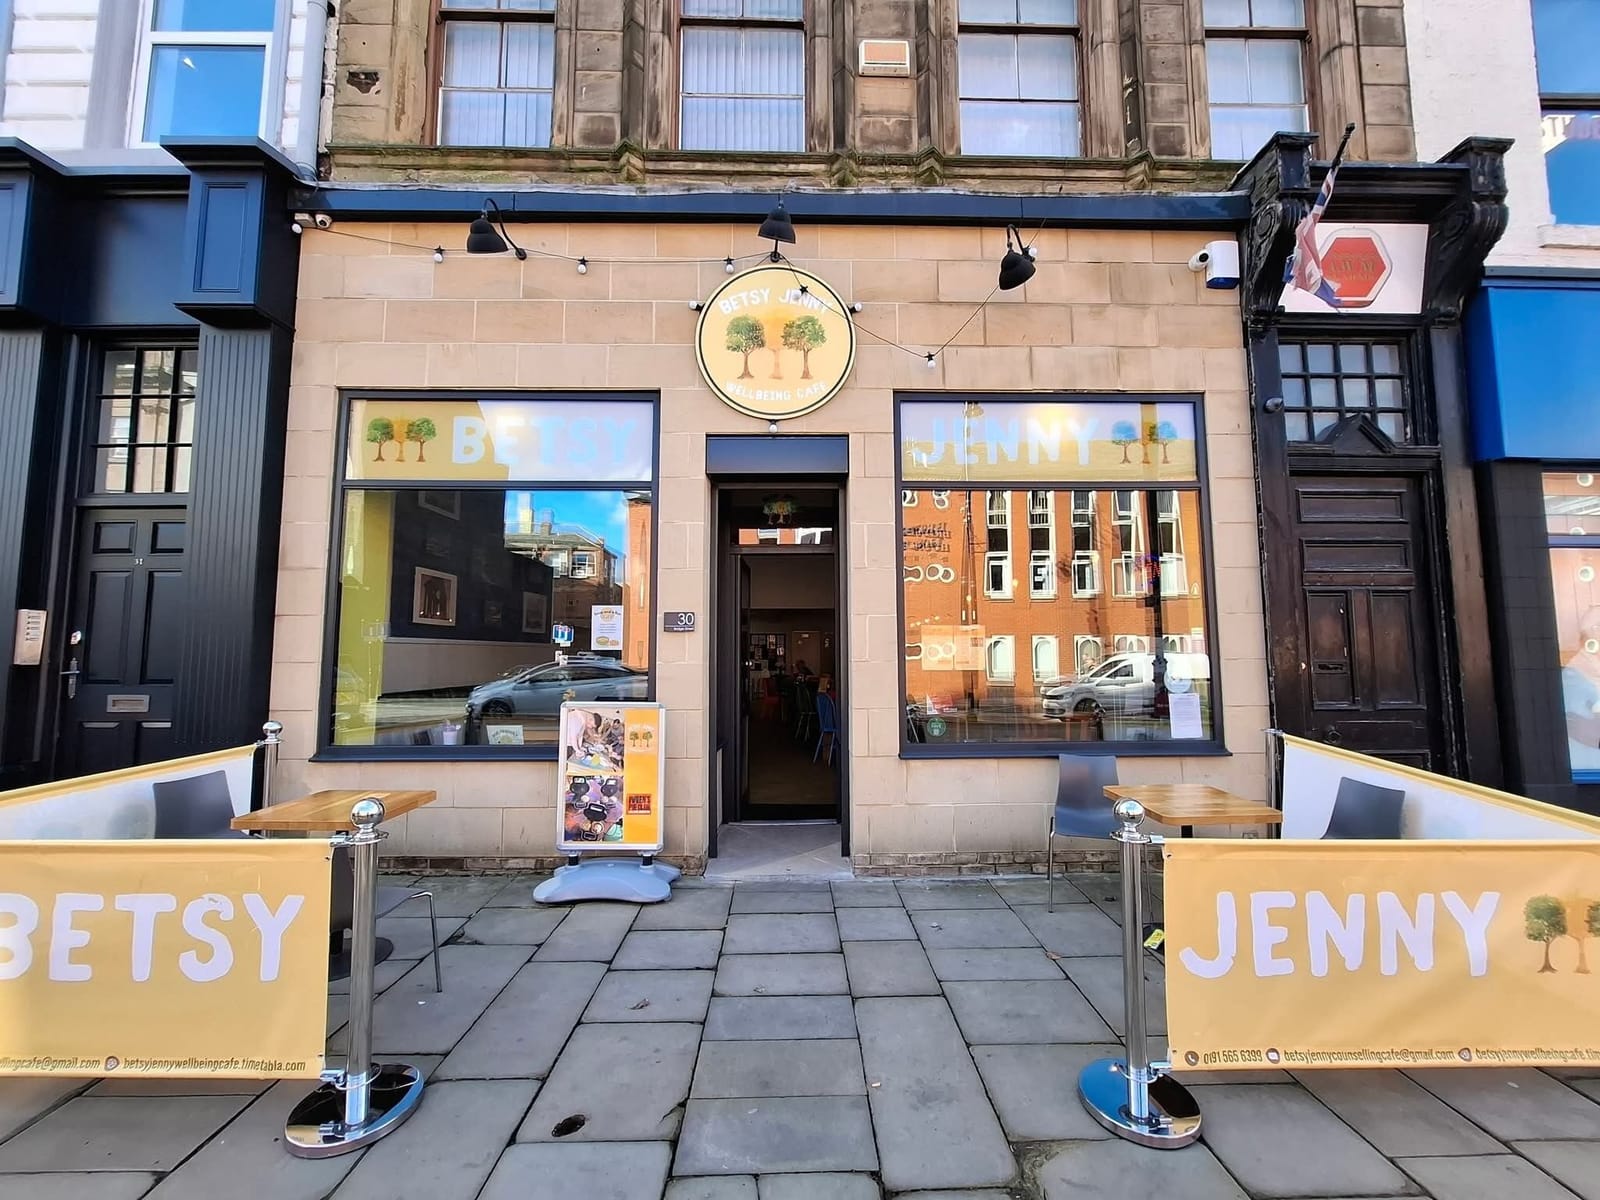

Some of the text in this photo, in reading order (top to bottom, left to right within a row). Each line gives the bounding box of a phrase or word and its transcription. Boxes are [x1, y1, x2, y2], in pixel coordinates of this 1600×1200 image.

[719, 287, 834, 315] BETSY JENNY
[725, 381, 827, 401] WELLBEING CAFE
[452, 415, 638, 465] BETSY
[917, 416, 1099, 465] JENNY
[677, 613, 694, 625] 30
[0, 892, 305, 982] BETSY
[1179, 891, 1500, 978] JENNY
[1203, 1049, 1263, 1064] 0191 565 6399
[1284, 1049, 1456, 1064] betsyjennycounsellingcafe@gmail.com
